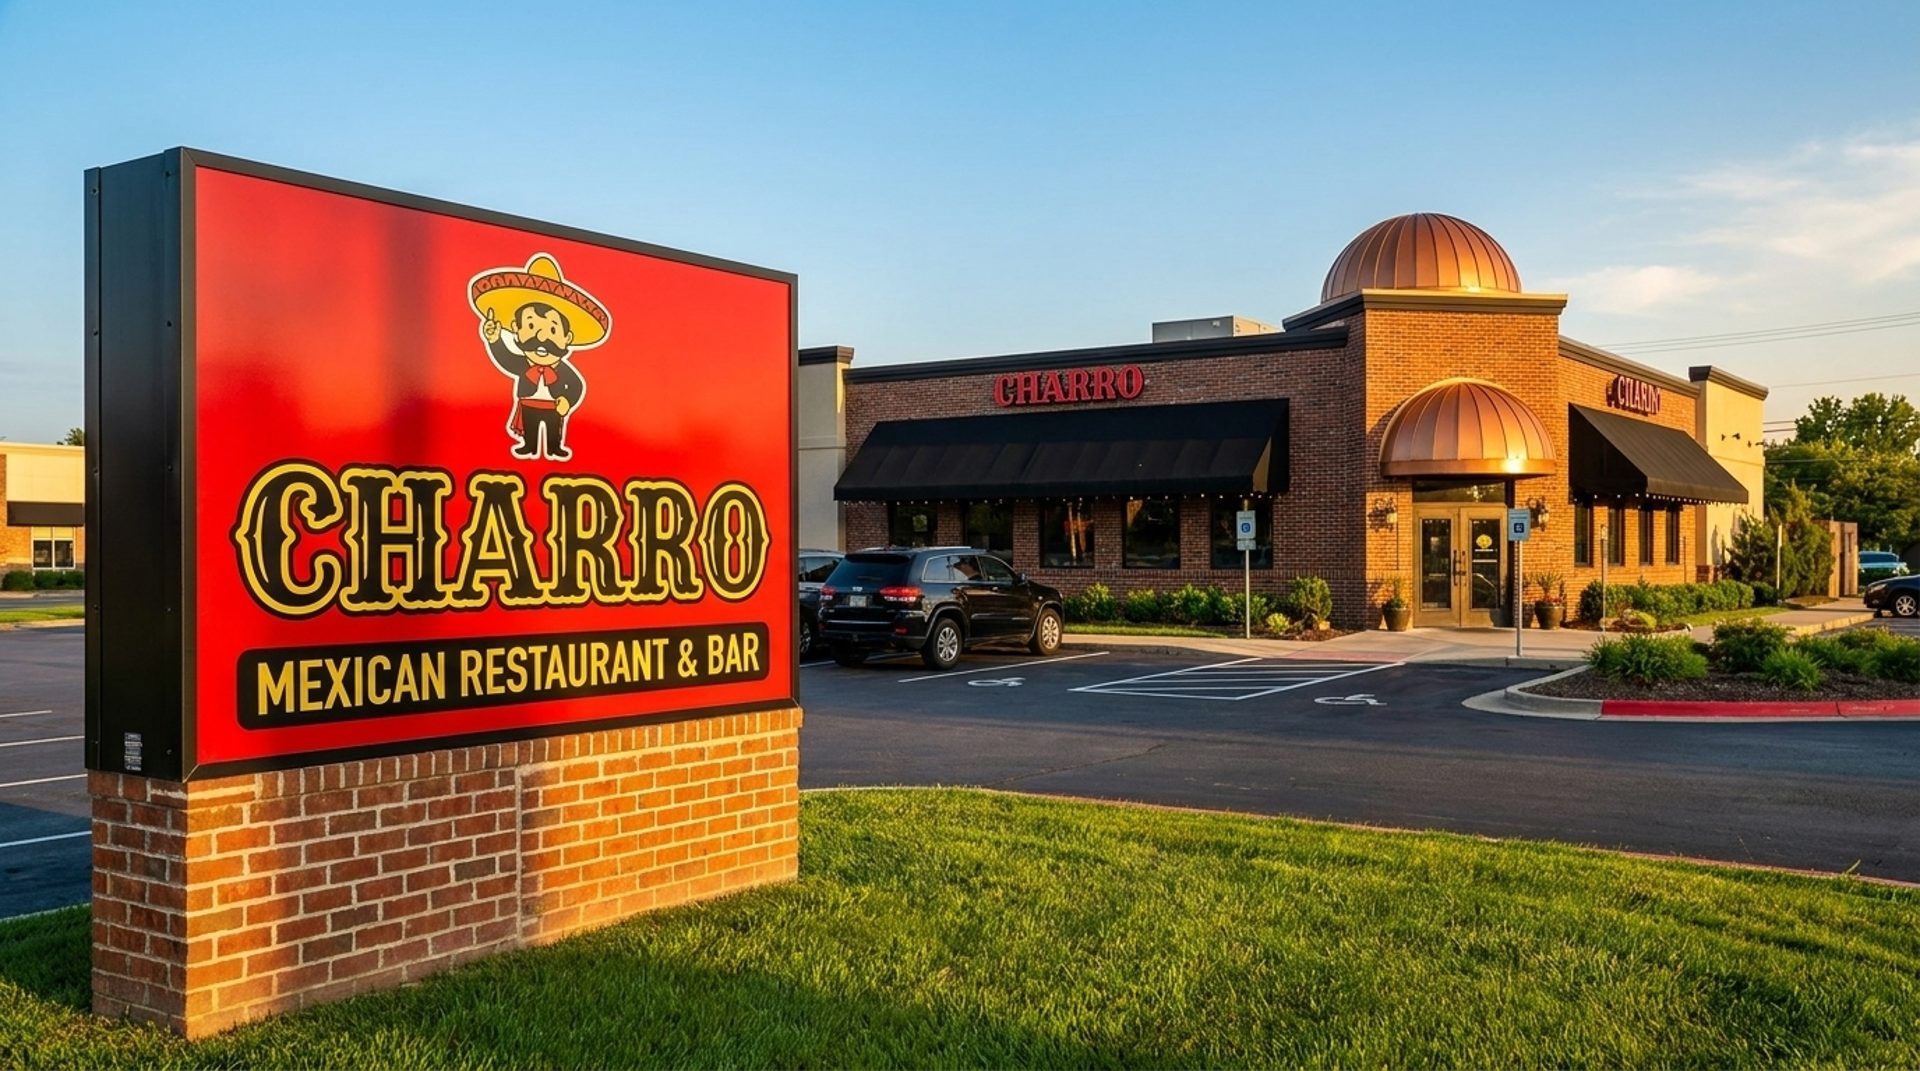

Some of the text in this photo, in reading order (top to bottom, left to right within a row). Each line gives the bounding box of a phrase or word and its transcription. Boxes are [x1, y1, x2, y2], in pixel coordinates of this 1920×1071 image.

[994, 364, 1144, 407] CHARRO
[230, 458, 772, 620] CHARRO
[257, 632, 760, 715] MEXICAN RESTAURANT & BAR
